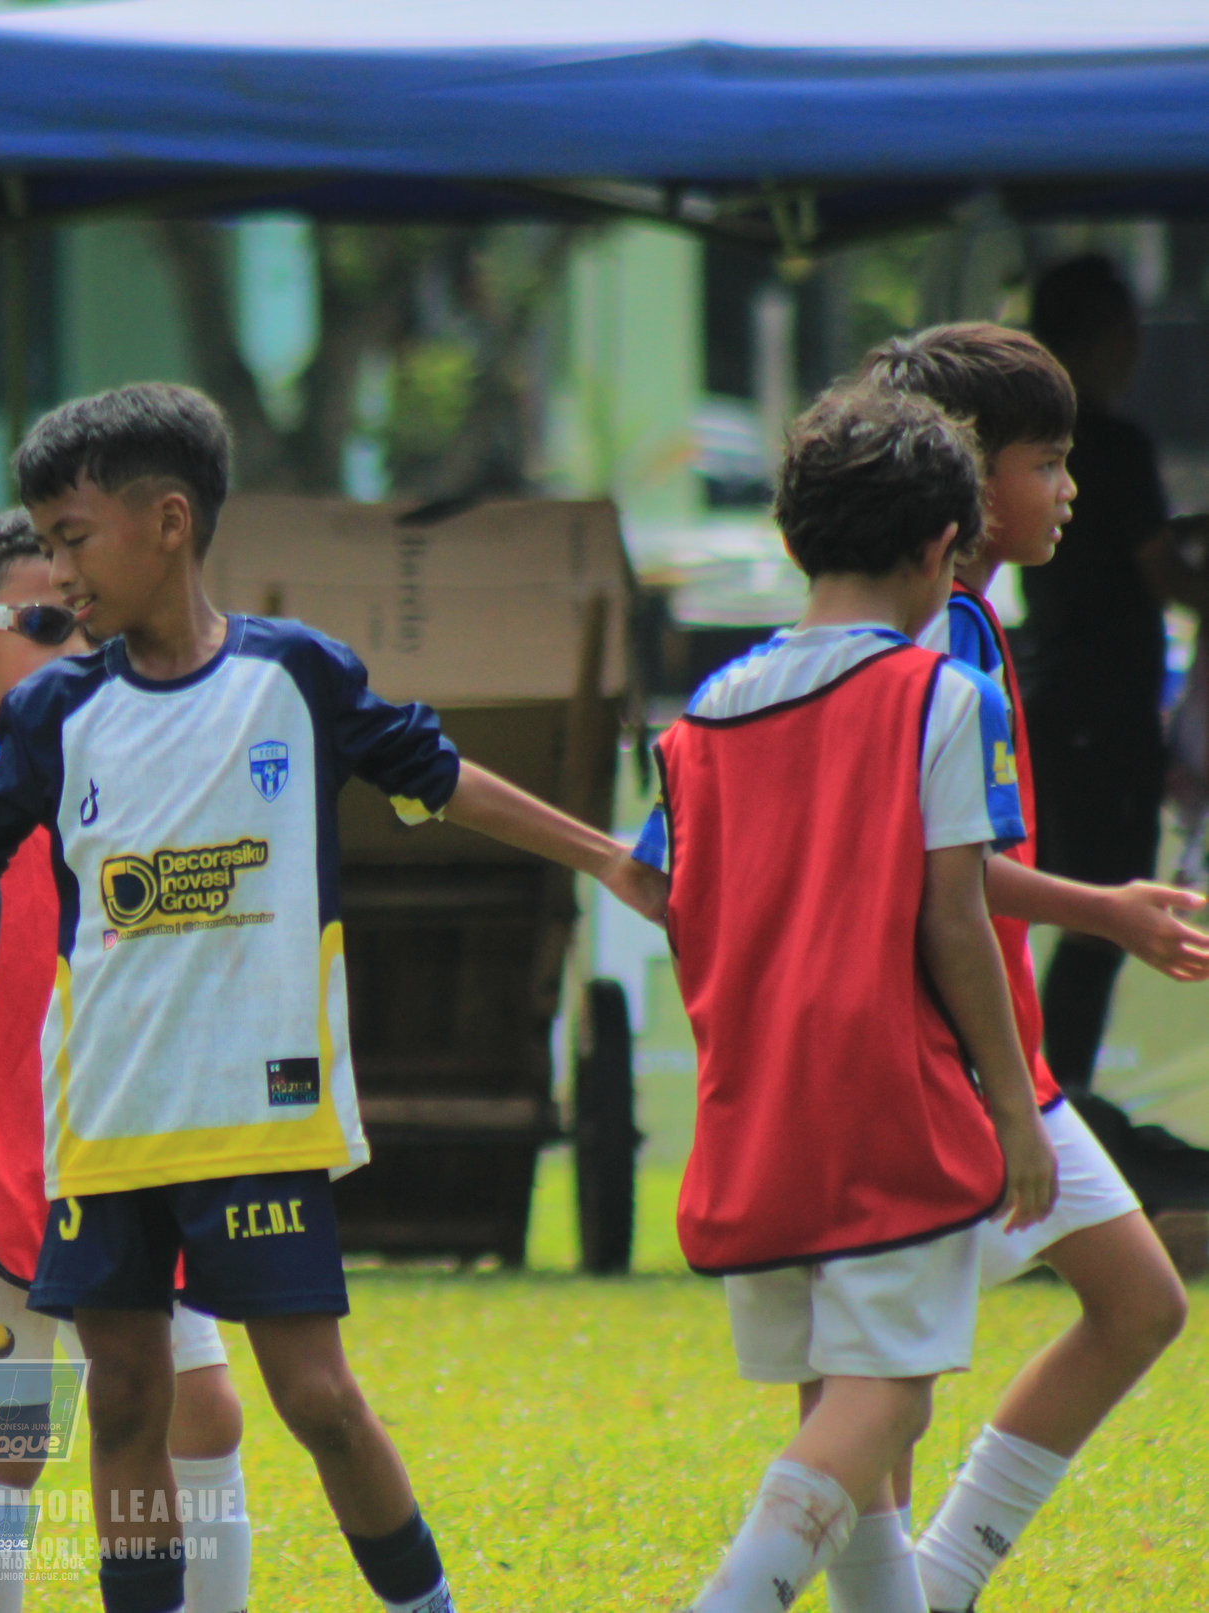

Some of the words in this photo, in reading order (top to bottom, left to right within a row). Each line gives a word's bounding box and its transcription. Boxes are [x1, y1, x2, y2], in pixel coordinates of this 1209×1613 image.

[158, 845, 266, 875] Decorasiku
[161, 867, 231, 894] Inovasi
[161, 891, 224, 912] Group
[226, 1200, 306, 1240] F.C.D.C
